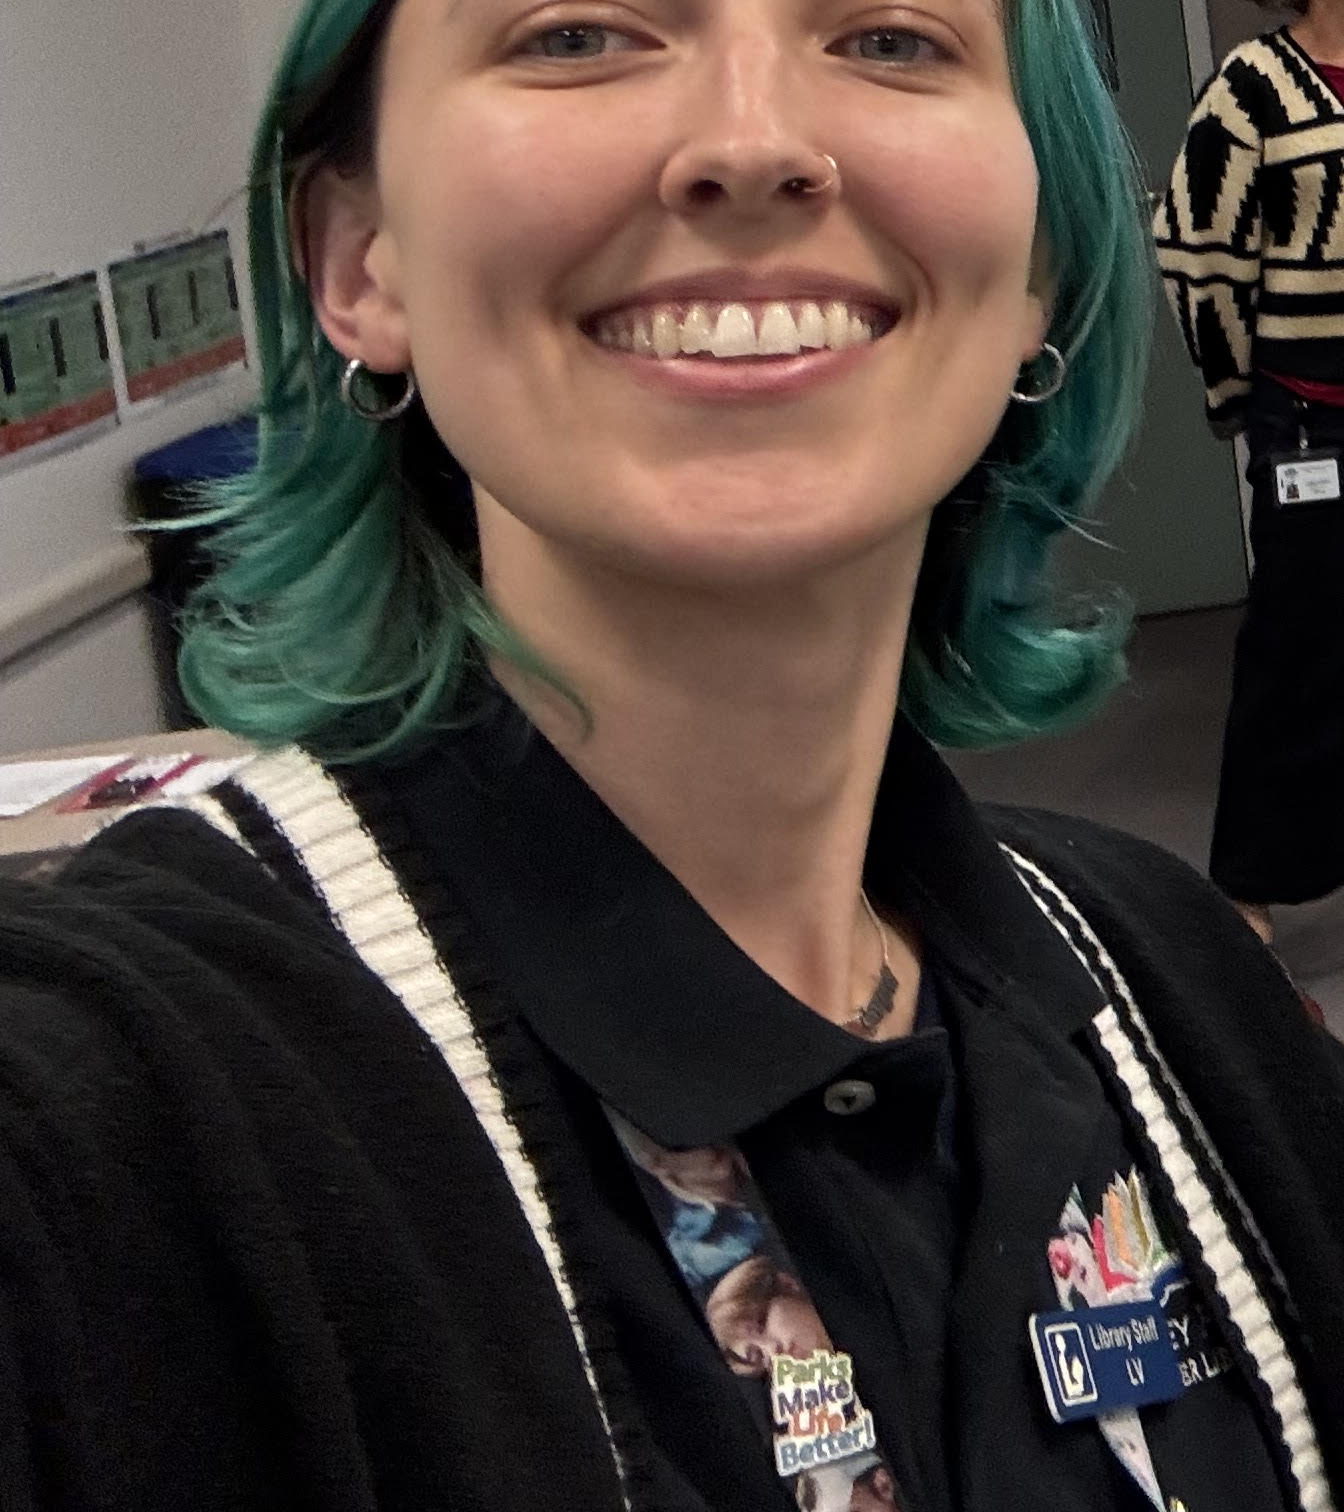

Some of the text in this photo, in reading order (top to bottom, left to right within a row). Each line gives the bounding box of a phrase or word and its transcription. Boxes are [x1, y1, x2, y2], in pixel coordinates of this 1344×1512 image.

[1088, 1321, 1133, 1353] Library
[1132, 1314, 1160, 1343] Staff
[777, 1356, 850, 1386] Parks
[778, 1379, 850, 1417] Make
[792, 1404, 844, 1437] Life
[780, 1417, 875, 1470] Better!
